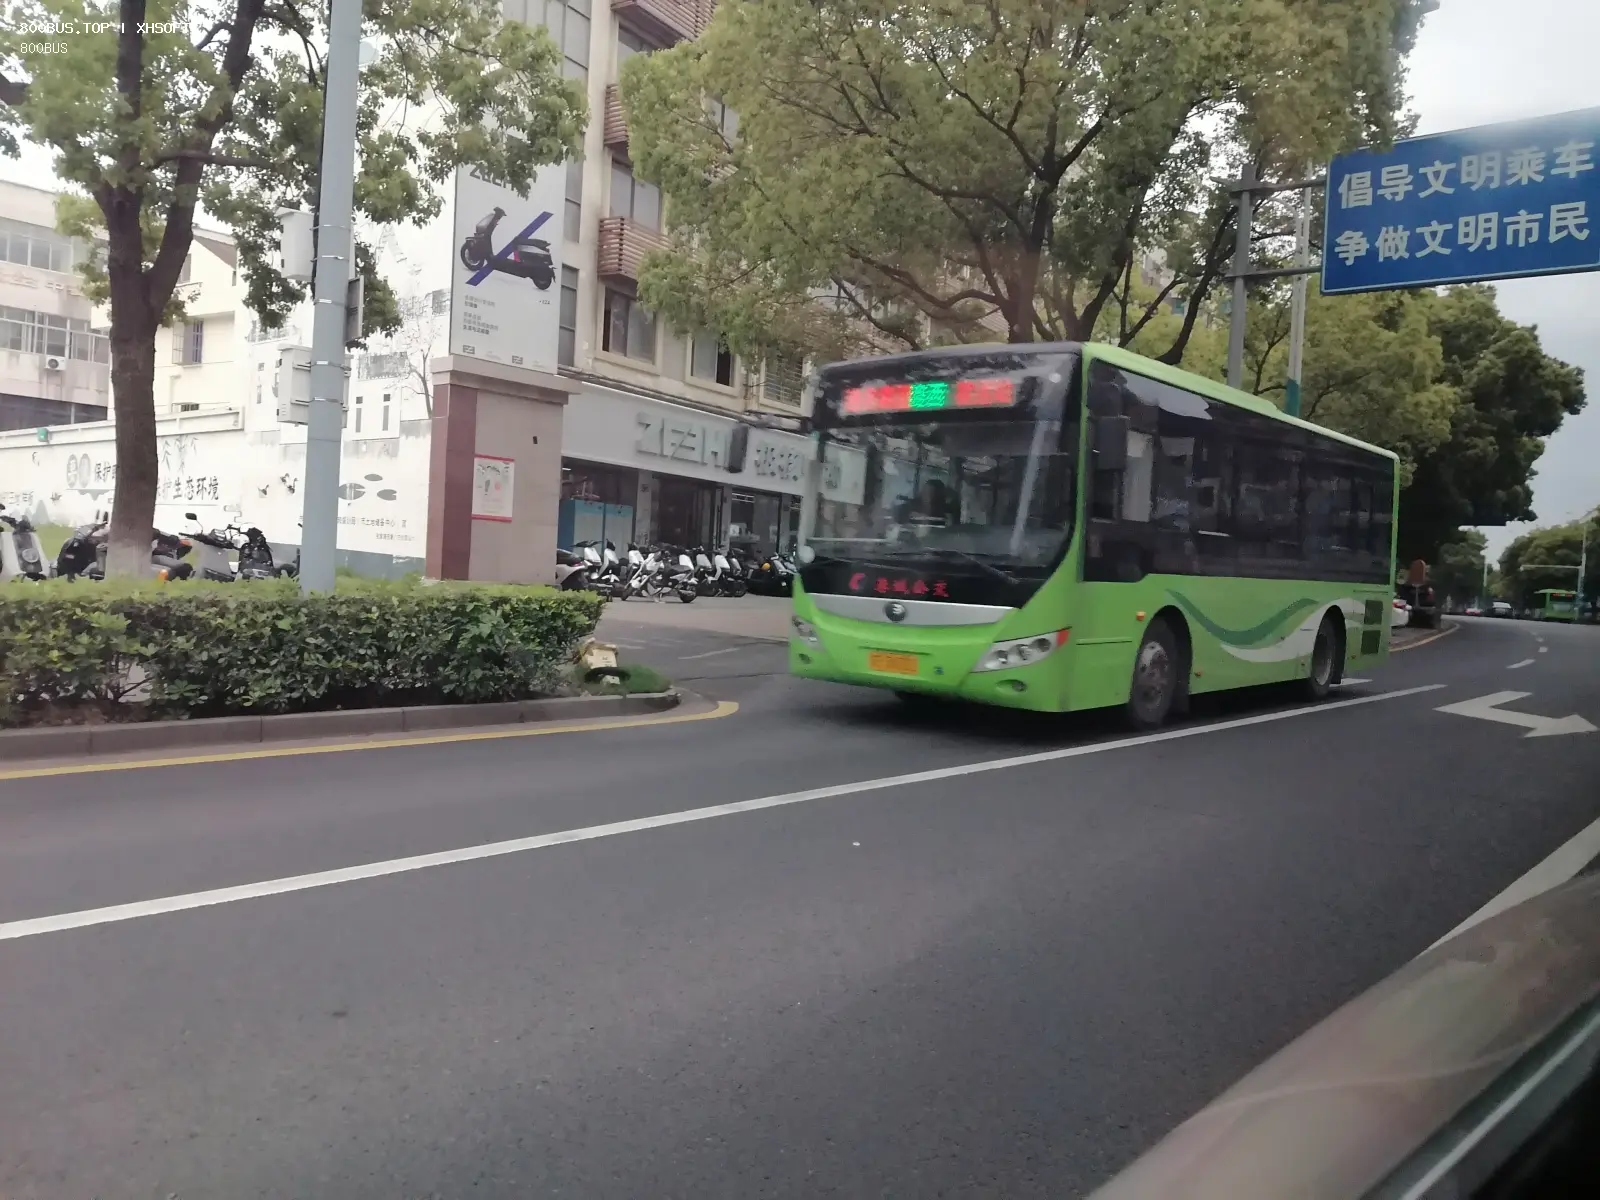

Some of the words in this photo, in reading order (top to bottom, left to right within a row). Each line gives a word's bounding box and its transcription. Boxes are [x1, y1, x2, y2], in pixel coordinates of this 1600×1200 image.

[1338, 140, 1595, 209] 倡导文明乘车
[1334, 200, 1591, 266] 争做文明市民
